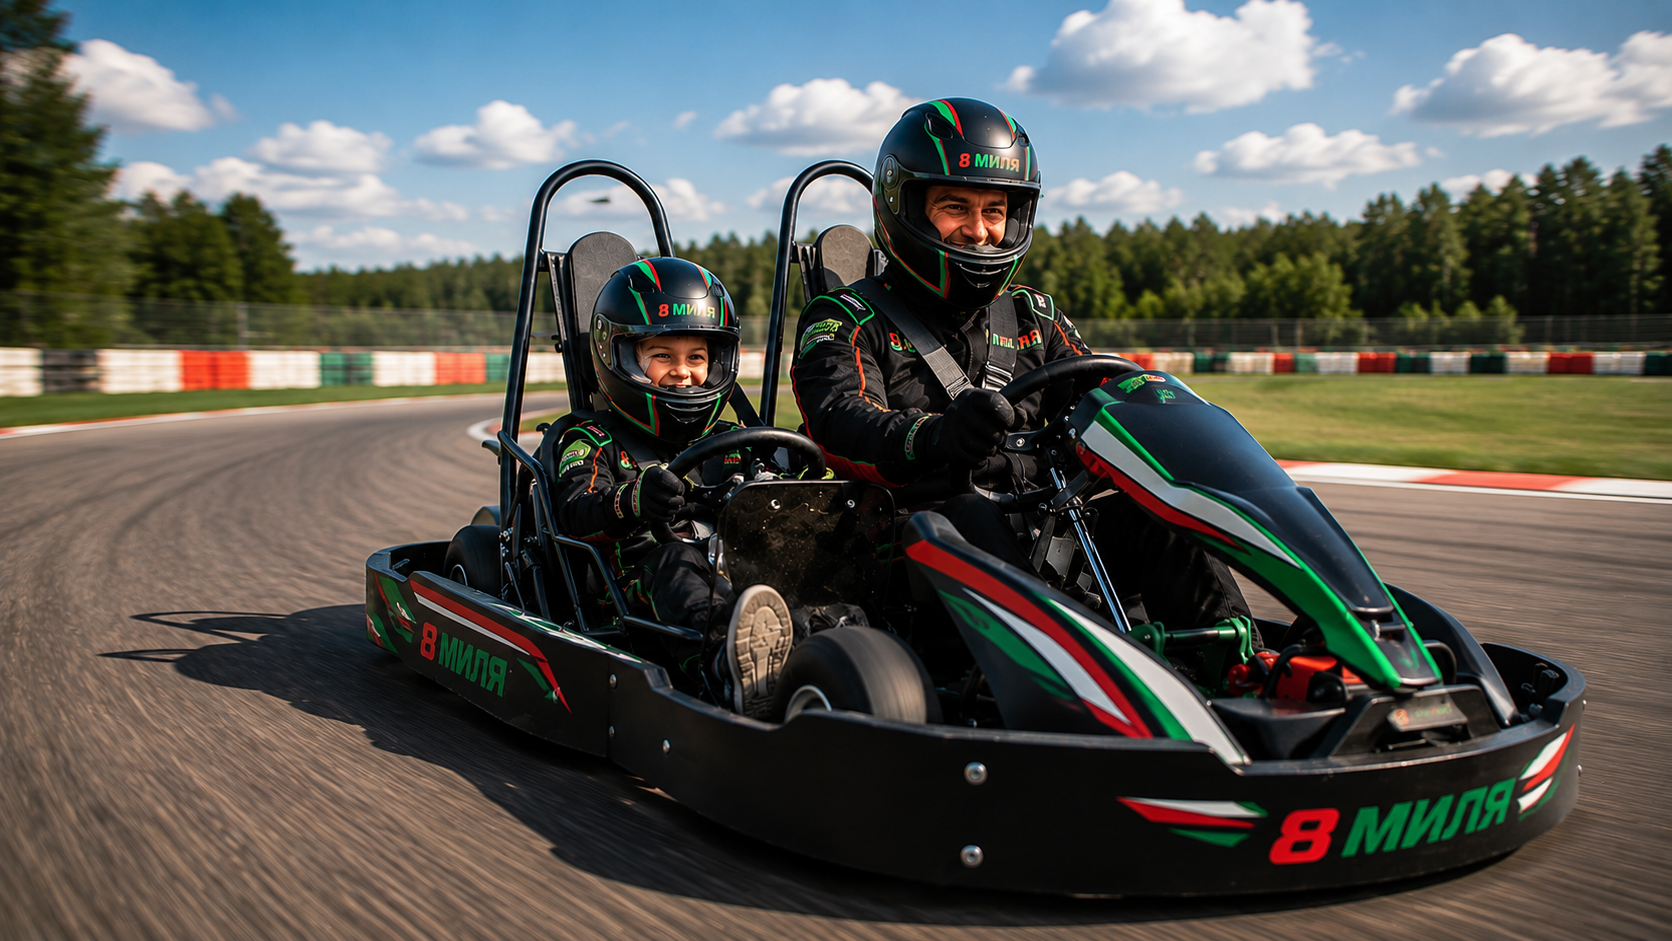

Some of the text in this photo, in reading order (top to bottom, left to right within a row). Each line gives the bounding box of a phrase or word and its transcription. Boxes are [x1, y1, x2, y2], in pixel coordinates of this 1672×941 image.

[959, 153, 1020, 173] 8 МИЛЯ
[658, 303, 669, 317] 8
[420, 621, 508, 697] 8 МИЛЯ
[1268, 777, 1517, 865] 8 МИЛЯ
